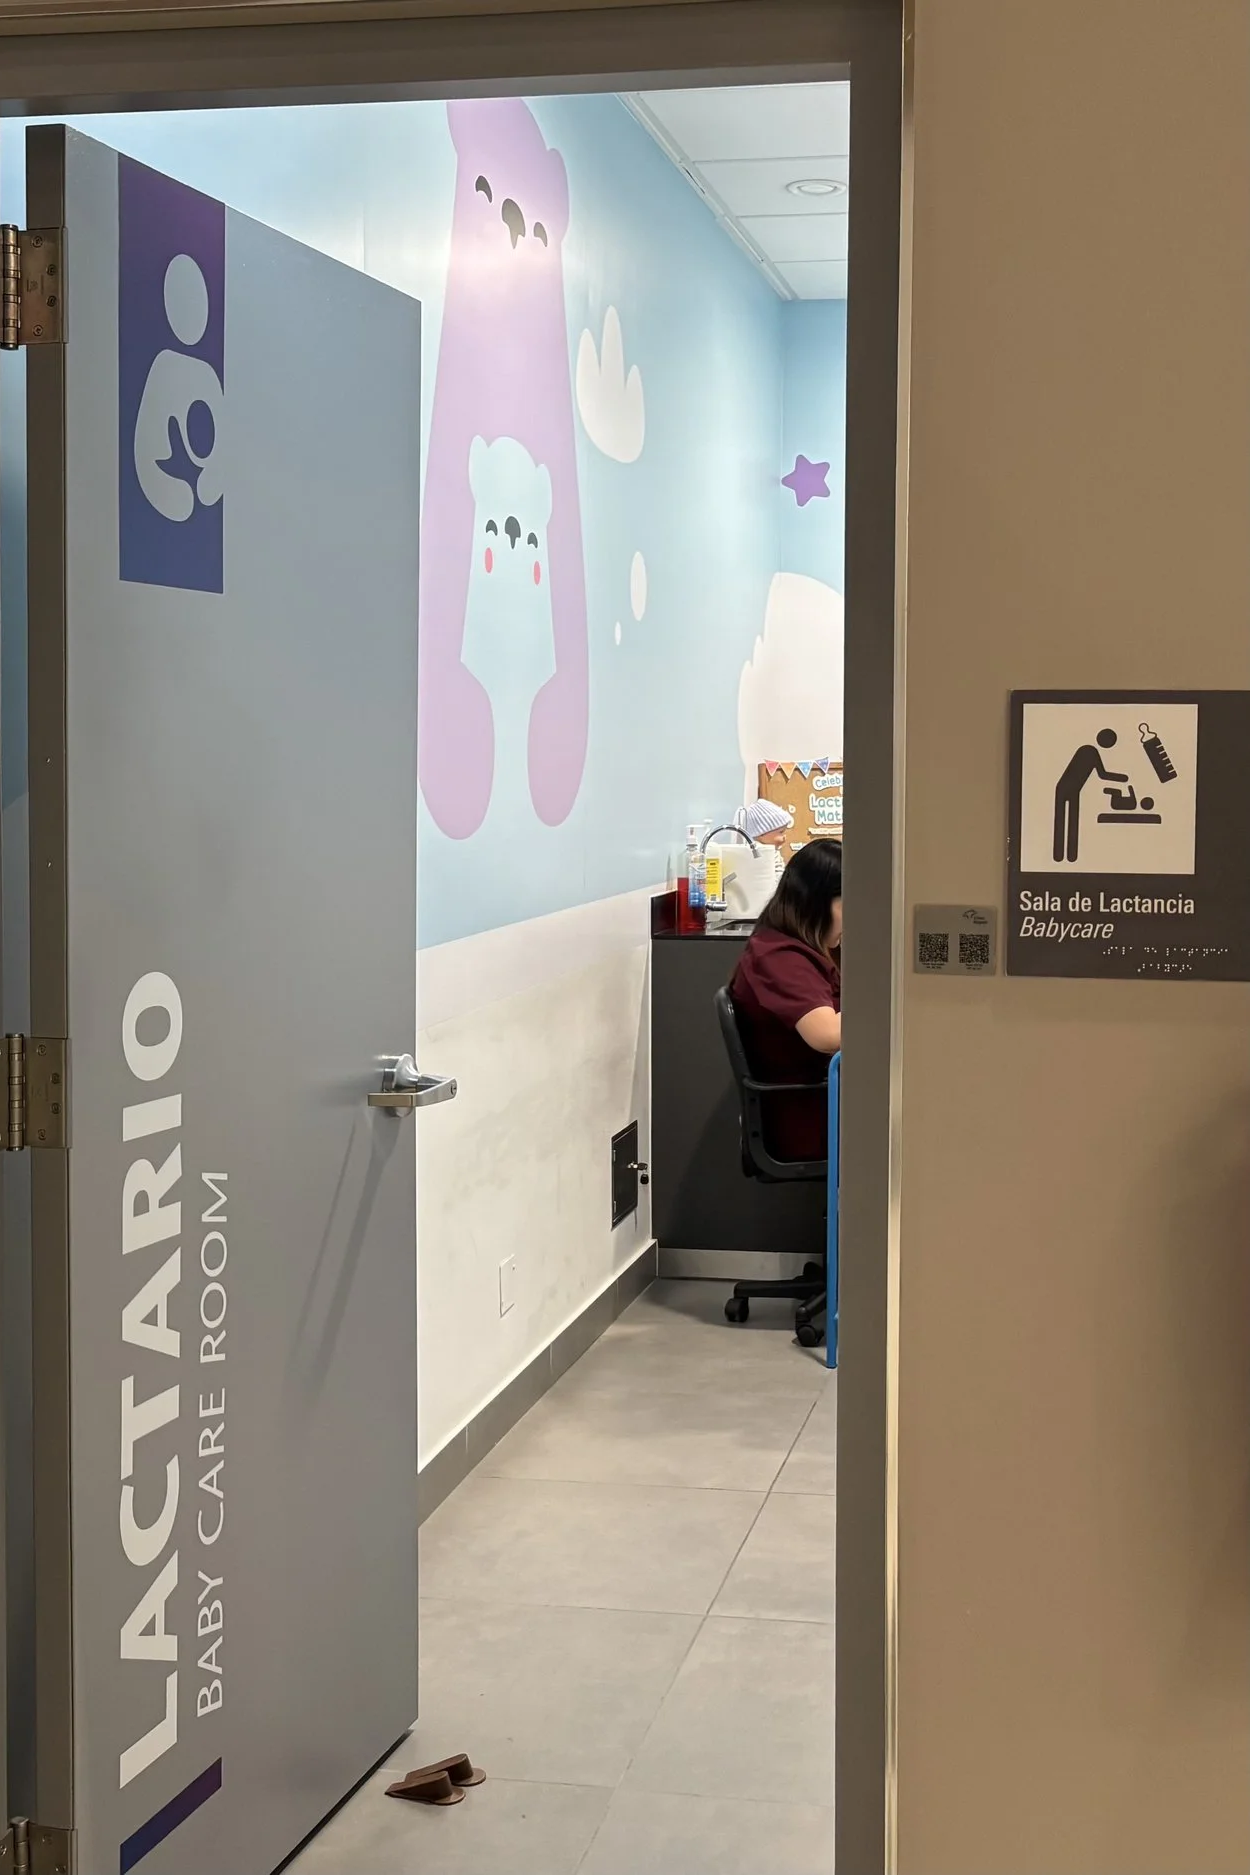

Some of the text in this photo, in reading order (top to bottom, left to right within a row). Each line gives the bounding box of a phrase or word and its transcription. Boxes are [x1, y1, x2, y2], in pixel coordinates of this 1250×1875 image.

[1019, 890, 1195, 914] Sala de Lactancia
[1019, 916, 1114, 943] Babycare
[119, 971, 183, 1789] LACTARIO
[197, 1172, 228, 1718] BABY CARE ROOM
